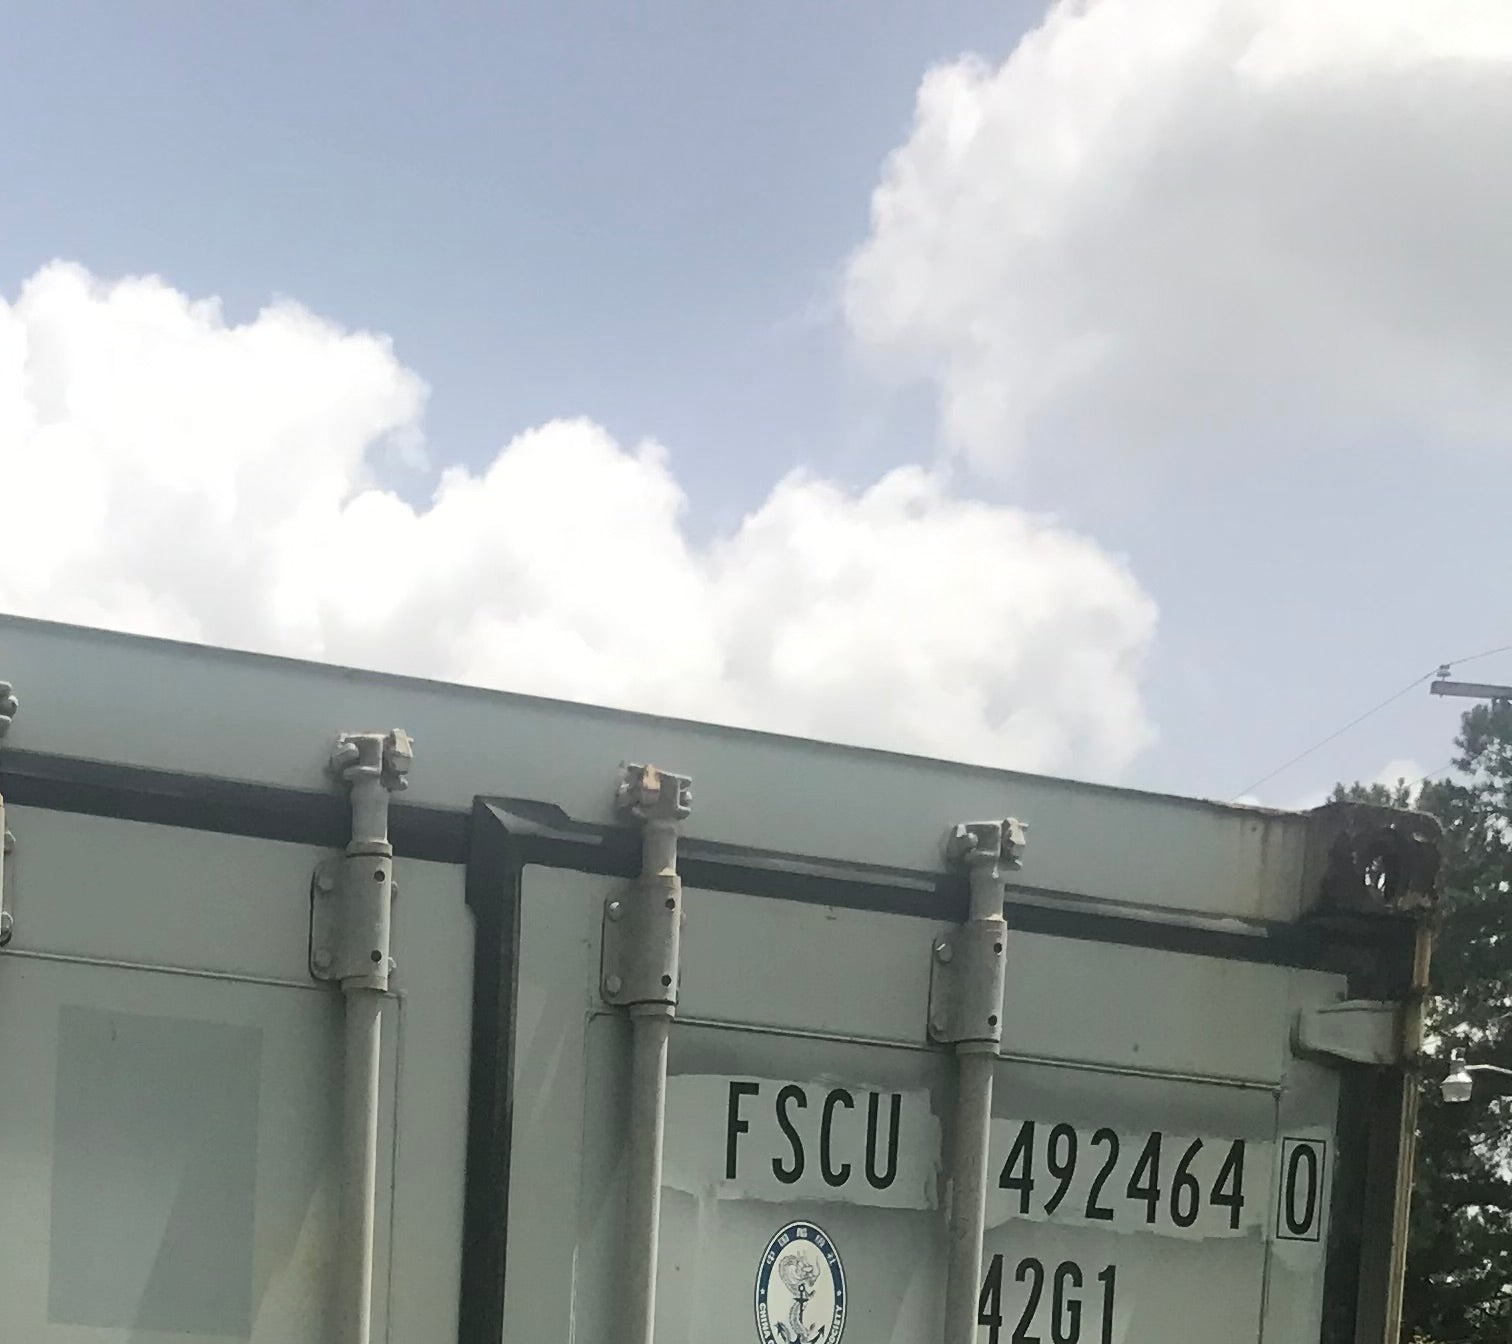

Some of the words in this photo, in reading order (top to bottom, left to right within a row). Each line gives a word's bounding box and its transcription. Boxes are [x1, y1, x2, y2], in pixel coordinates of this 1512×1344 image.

[725, 1081, 902, 1190] FSCU
[998, 1120, 1246, 1230] 492464
[1285, 1143, 1318, 1235] 0
